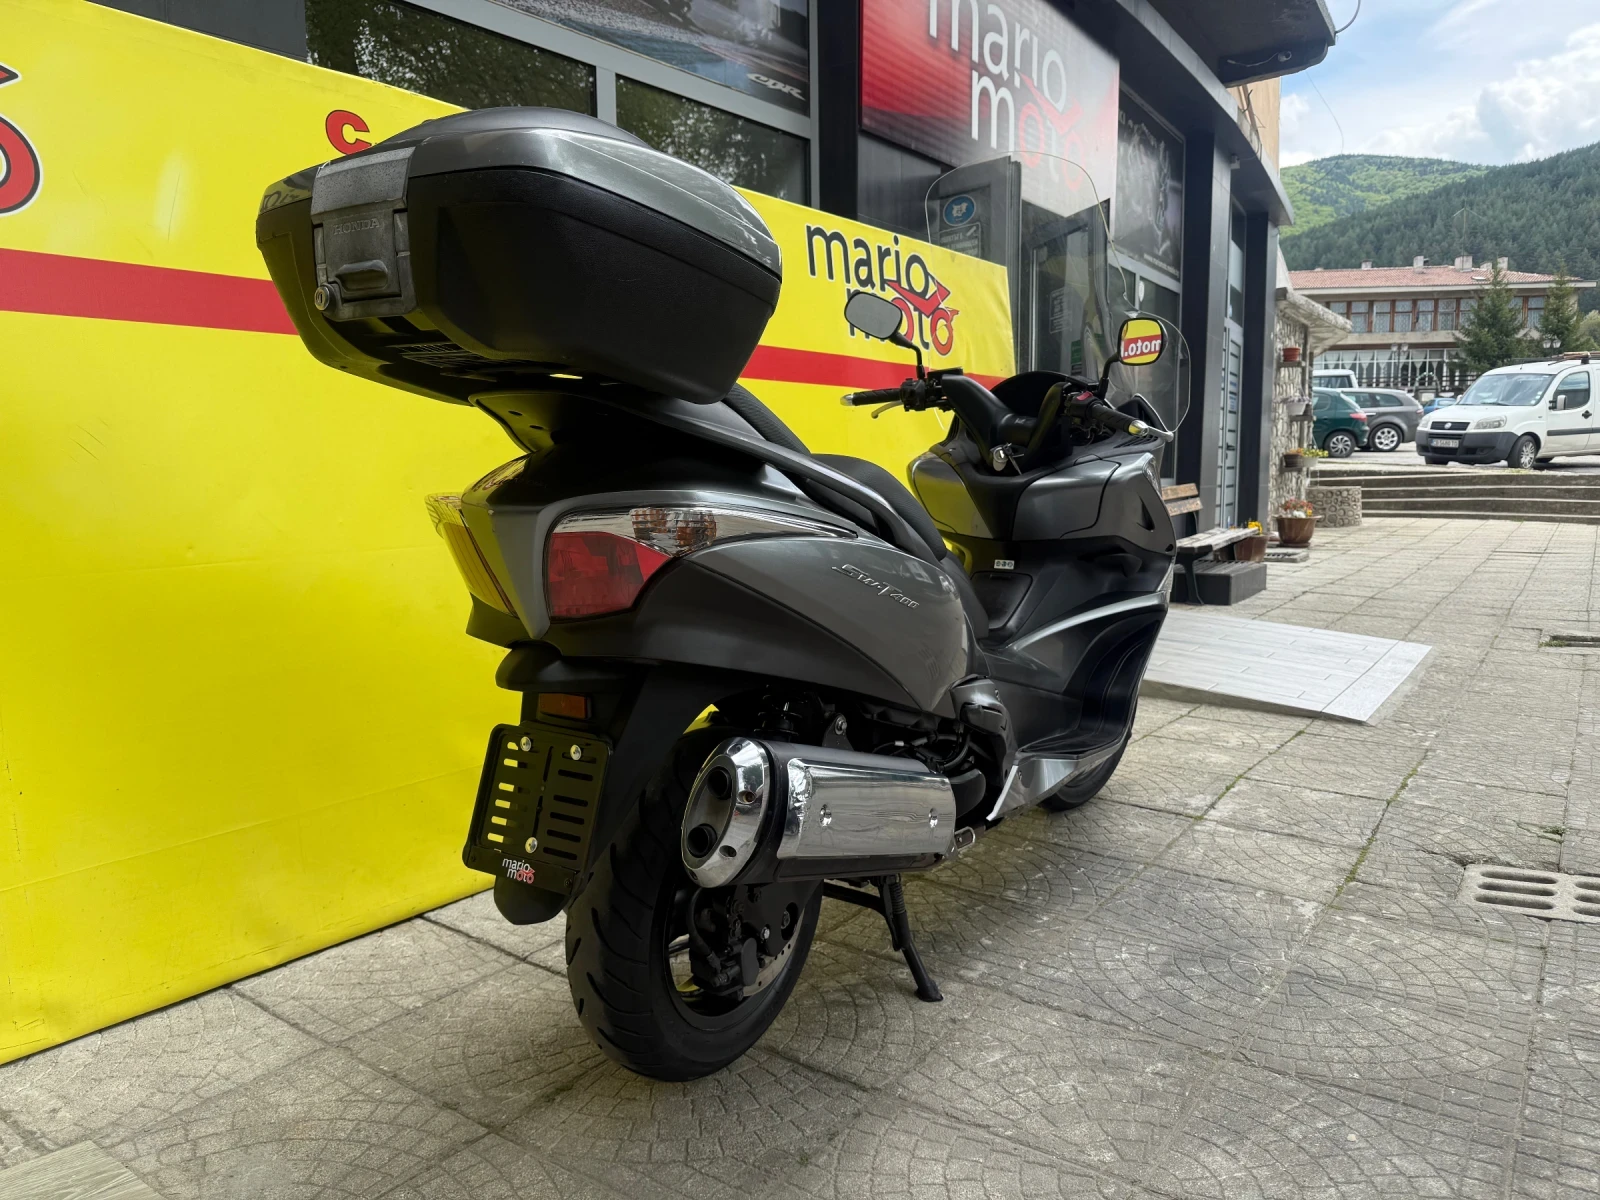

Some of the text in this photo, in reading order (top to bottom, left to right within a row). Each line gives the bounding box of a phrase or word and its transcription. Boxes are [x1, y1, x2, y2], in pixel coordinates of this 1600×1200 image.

[971, 69, 1087, 192] moto
[333, 217, 381, 235] HONDA
[806, 224, 930, 299] mario
[502, 858, 531, 873] mario
[507, 868, 535, 885] moto
